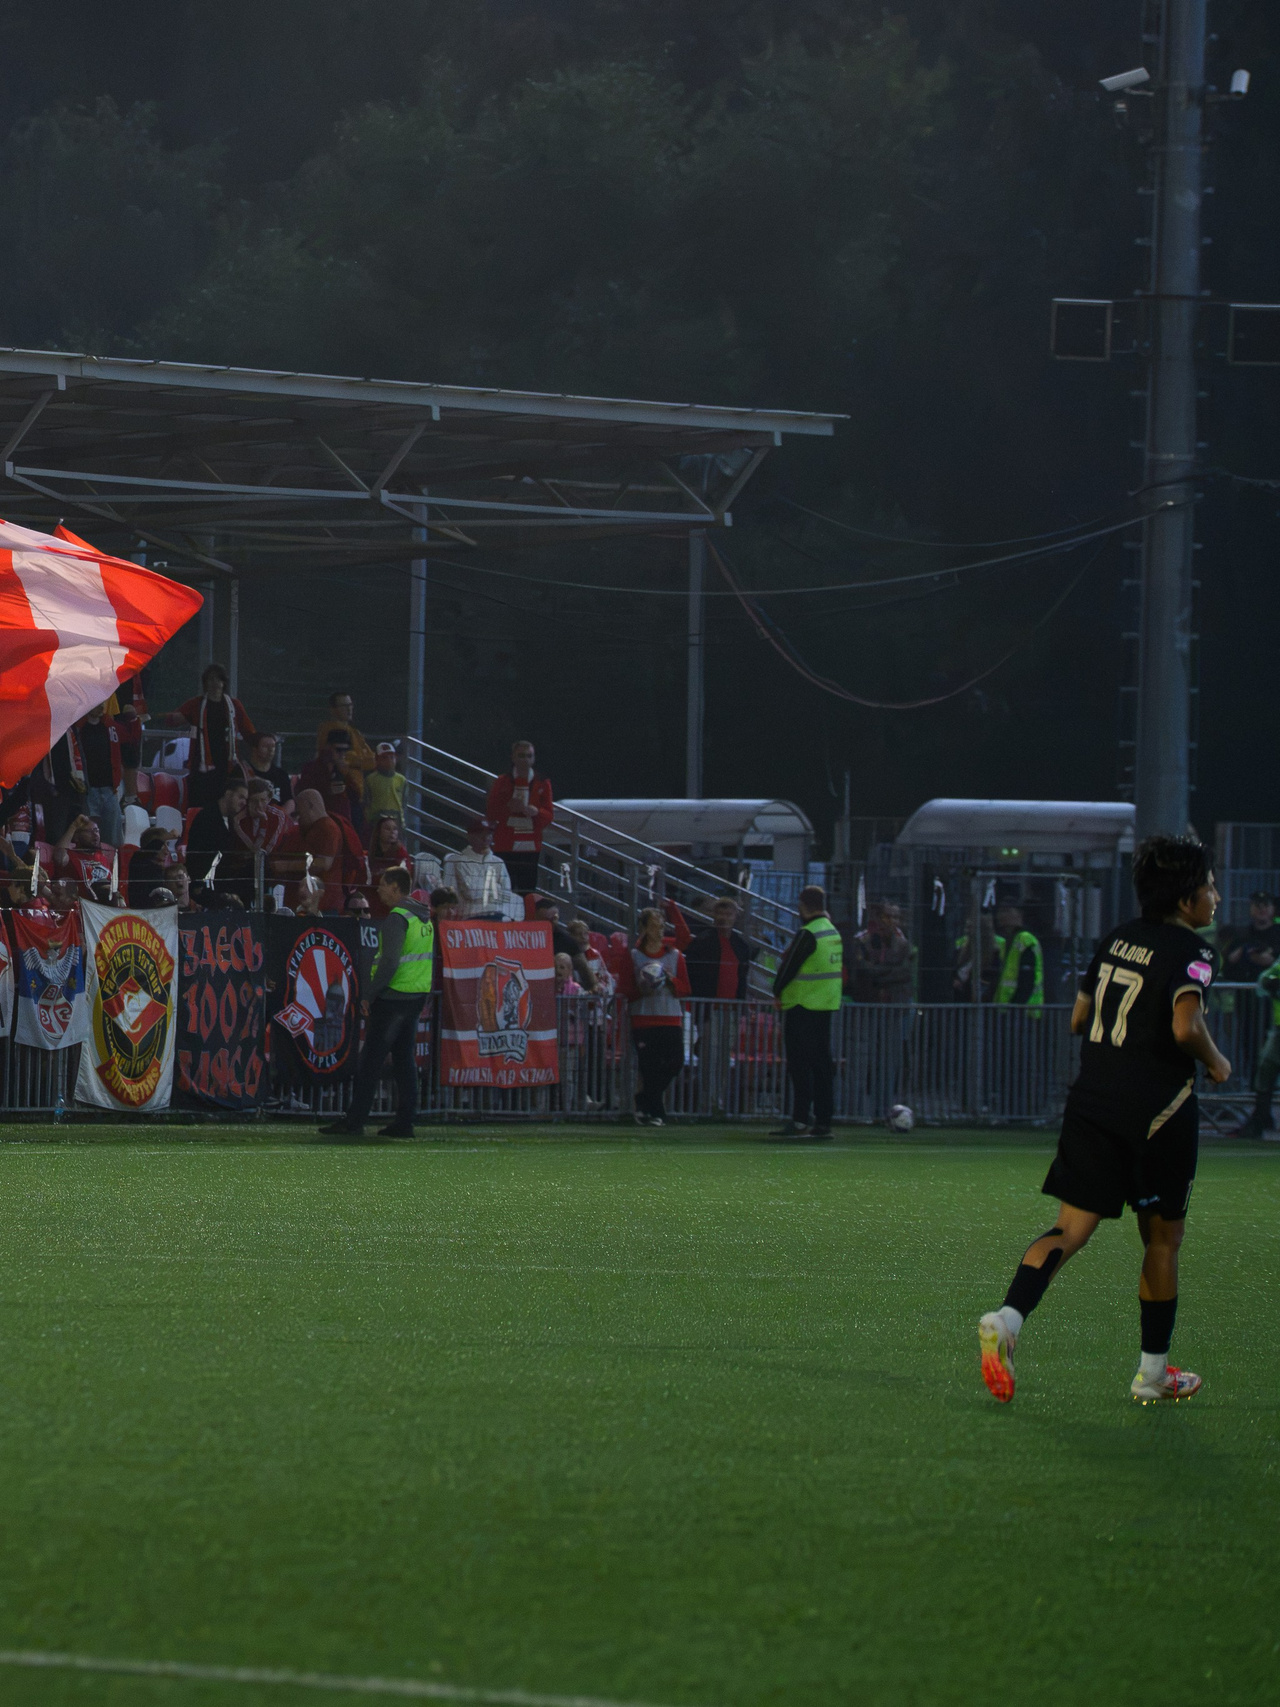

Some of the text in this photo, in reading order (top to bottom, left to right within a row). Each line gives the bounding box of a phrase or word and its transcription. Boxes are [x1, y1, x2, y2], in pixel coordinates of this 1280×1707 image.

[132, 921, 174, 977] MOSCOW
[179, 925, 264, 977] ЗДЕСЬ
[446, 928, 499, 949] SPARTAK
[503, 930, 547, 949] MOSCOW
[182, 978, 264, 1044] 100%
[1089, 962, 1145, 1048] 17
